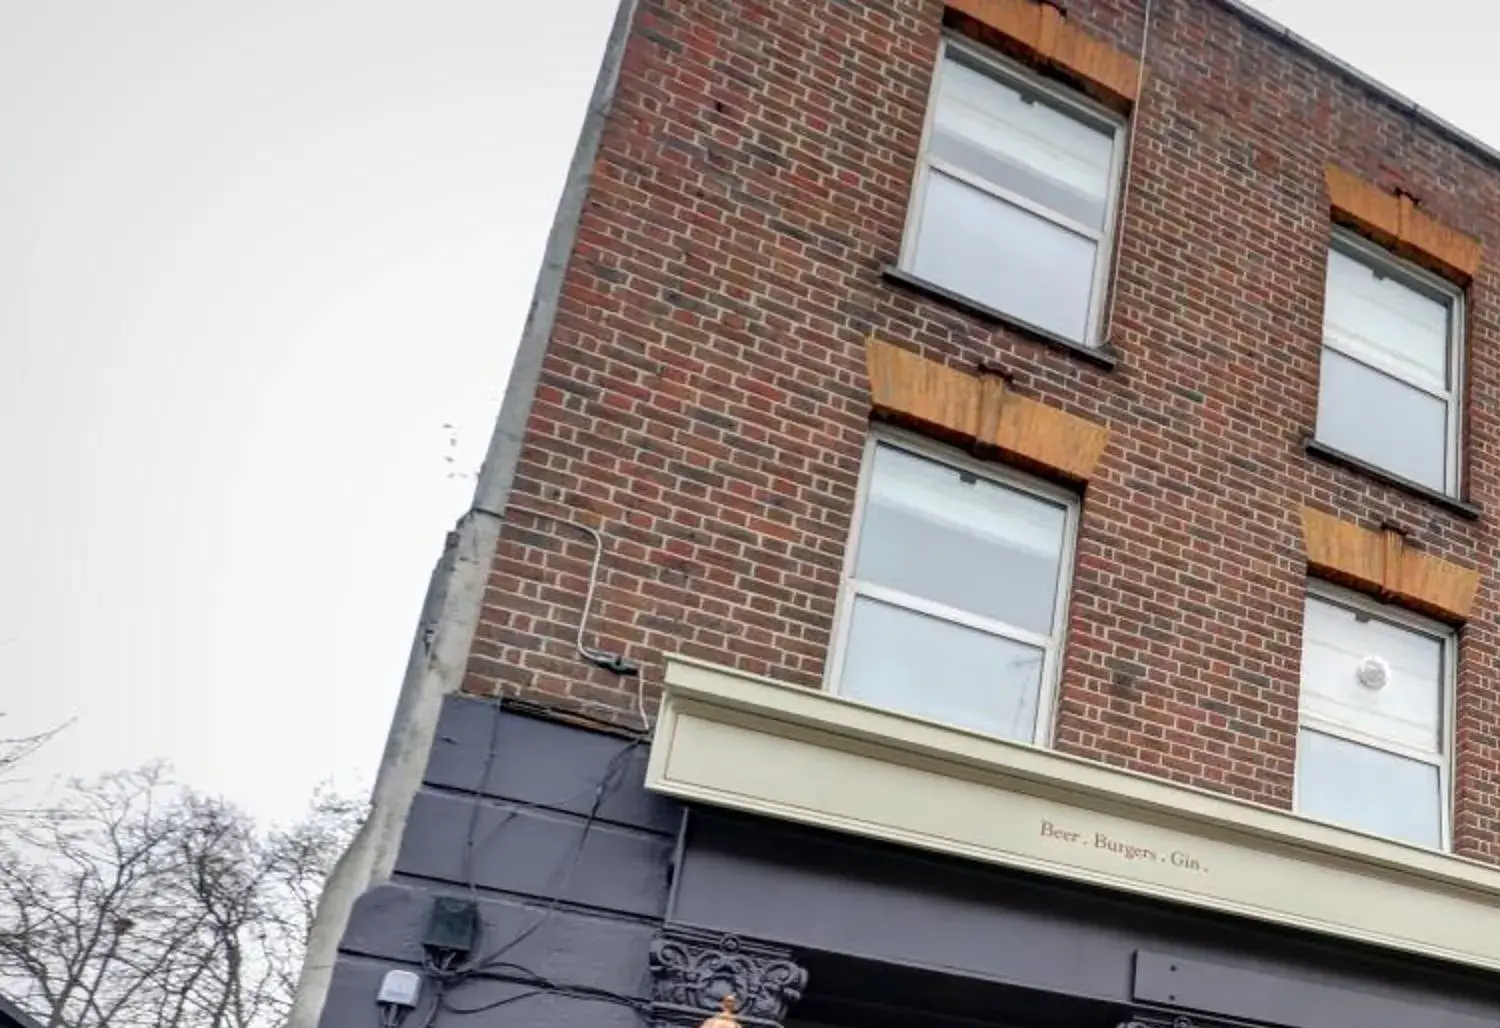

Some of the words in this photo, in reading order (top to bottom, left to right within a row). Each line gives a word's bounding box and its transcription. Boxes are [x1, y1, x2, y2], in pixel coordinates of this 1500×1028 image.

[1040, 819, 1079, 843] Beer
[1094, 831, 1157, 861] Burgers
[1170, 849, 1201, 871] Gin
